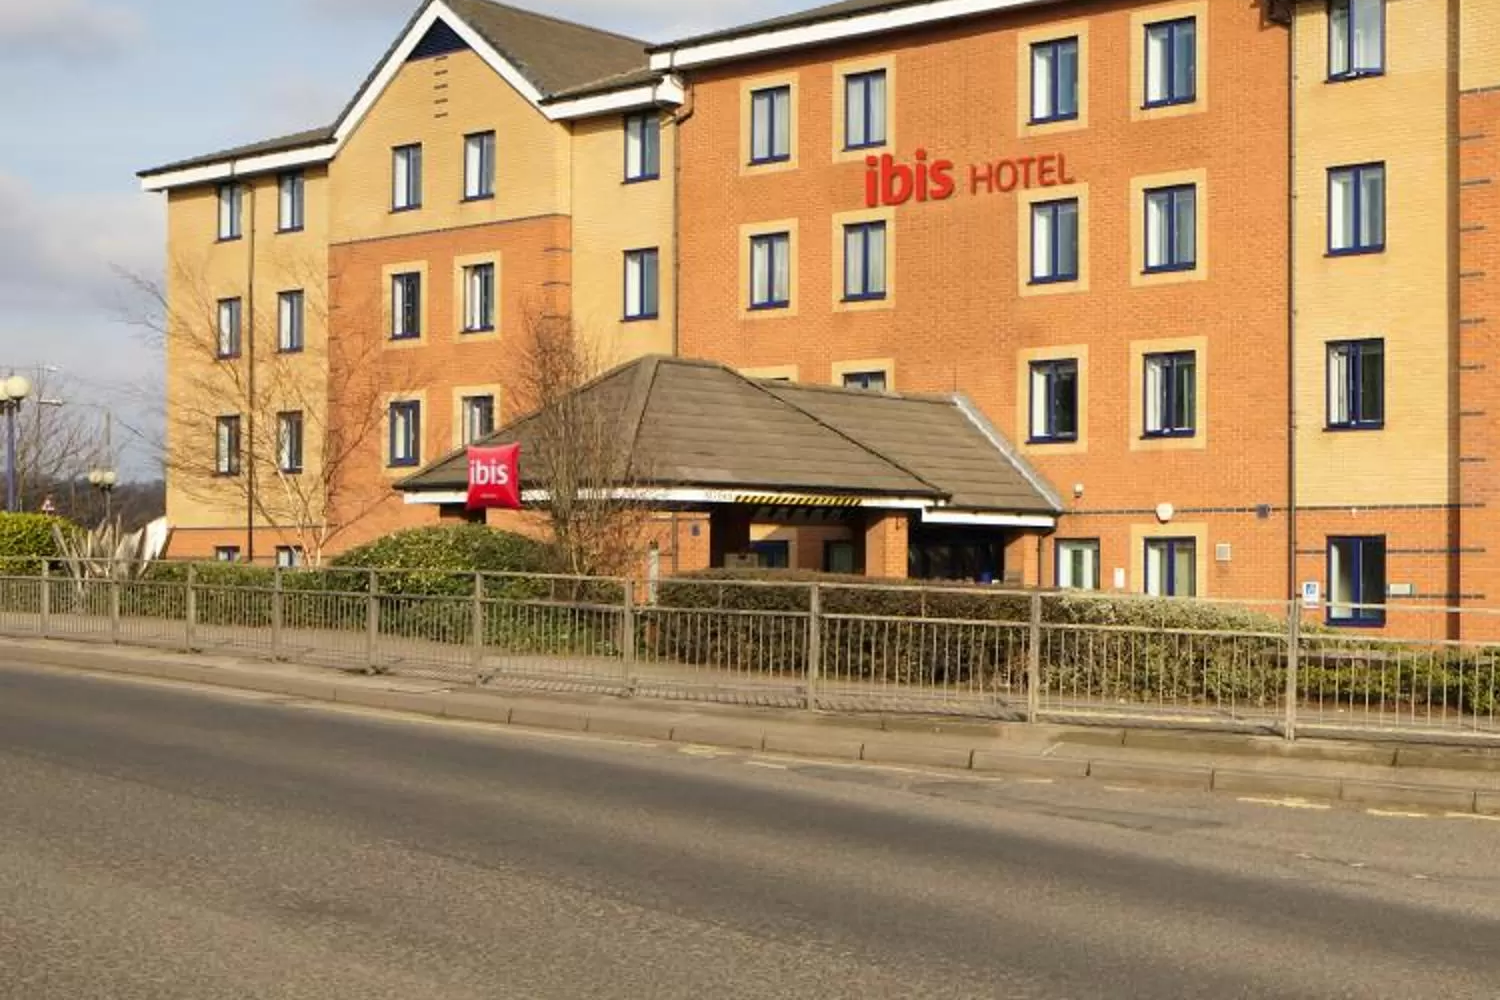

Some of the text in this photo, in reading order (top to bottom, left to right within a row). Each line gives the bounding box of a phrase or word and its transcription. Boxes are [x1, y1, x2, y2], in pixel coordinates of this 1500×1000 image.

[865, 148, 1076, 208] ibis HOTEL
[470, 458, 509, 485] ibis
